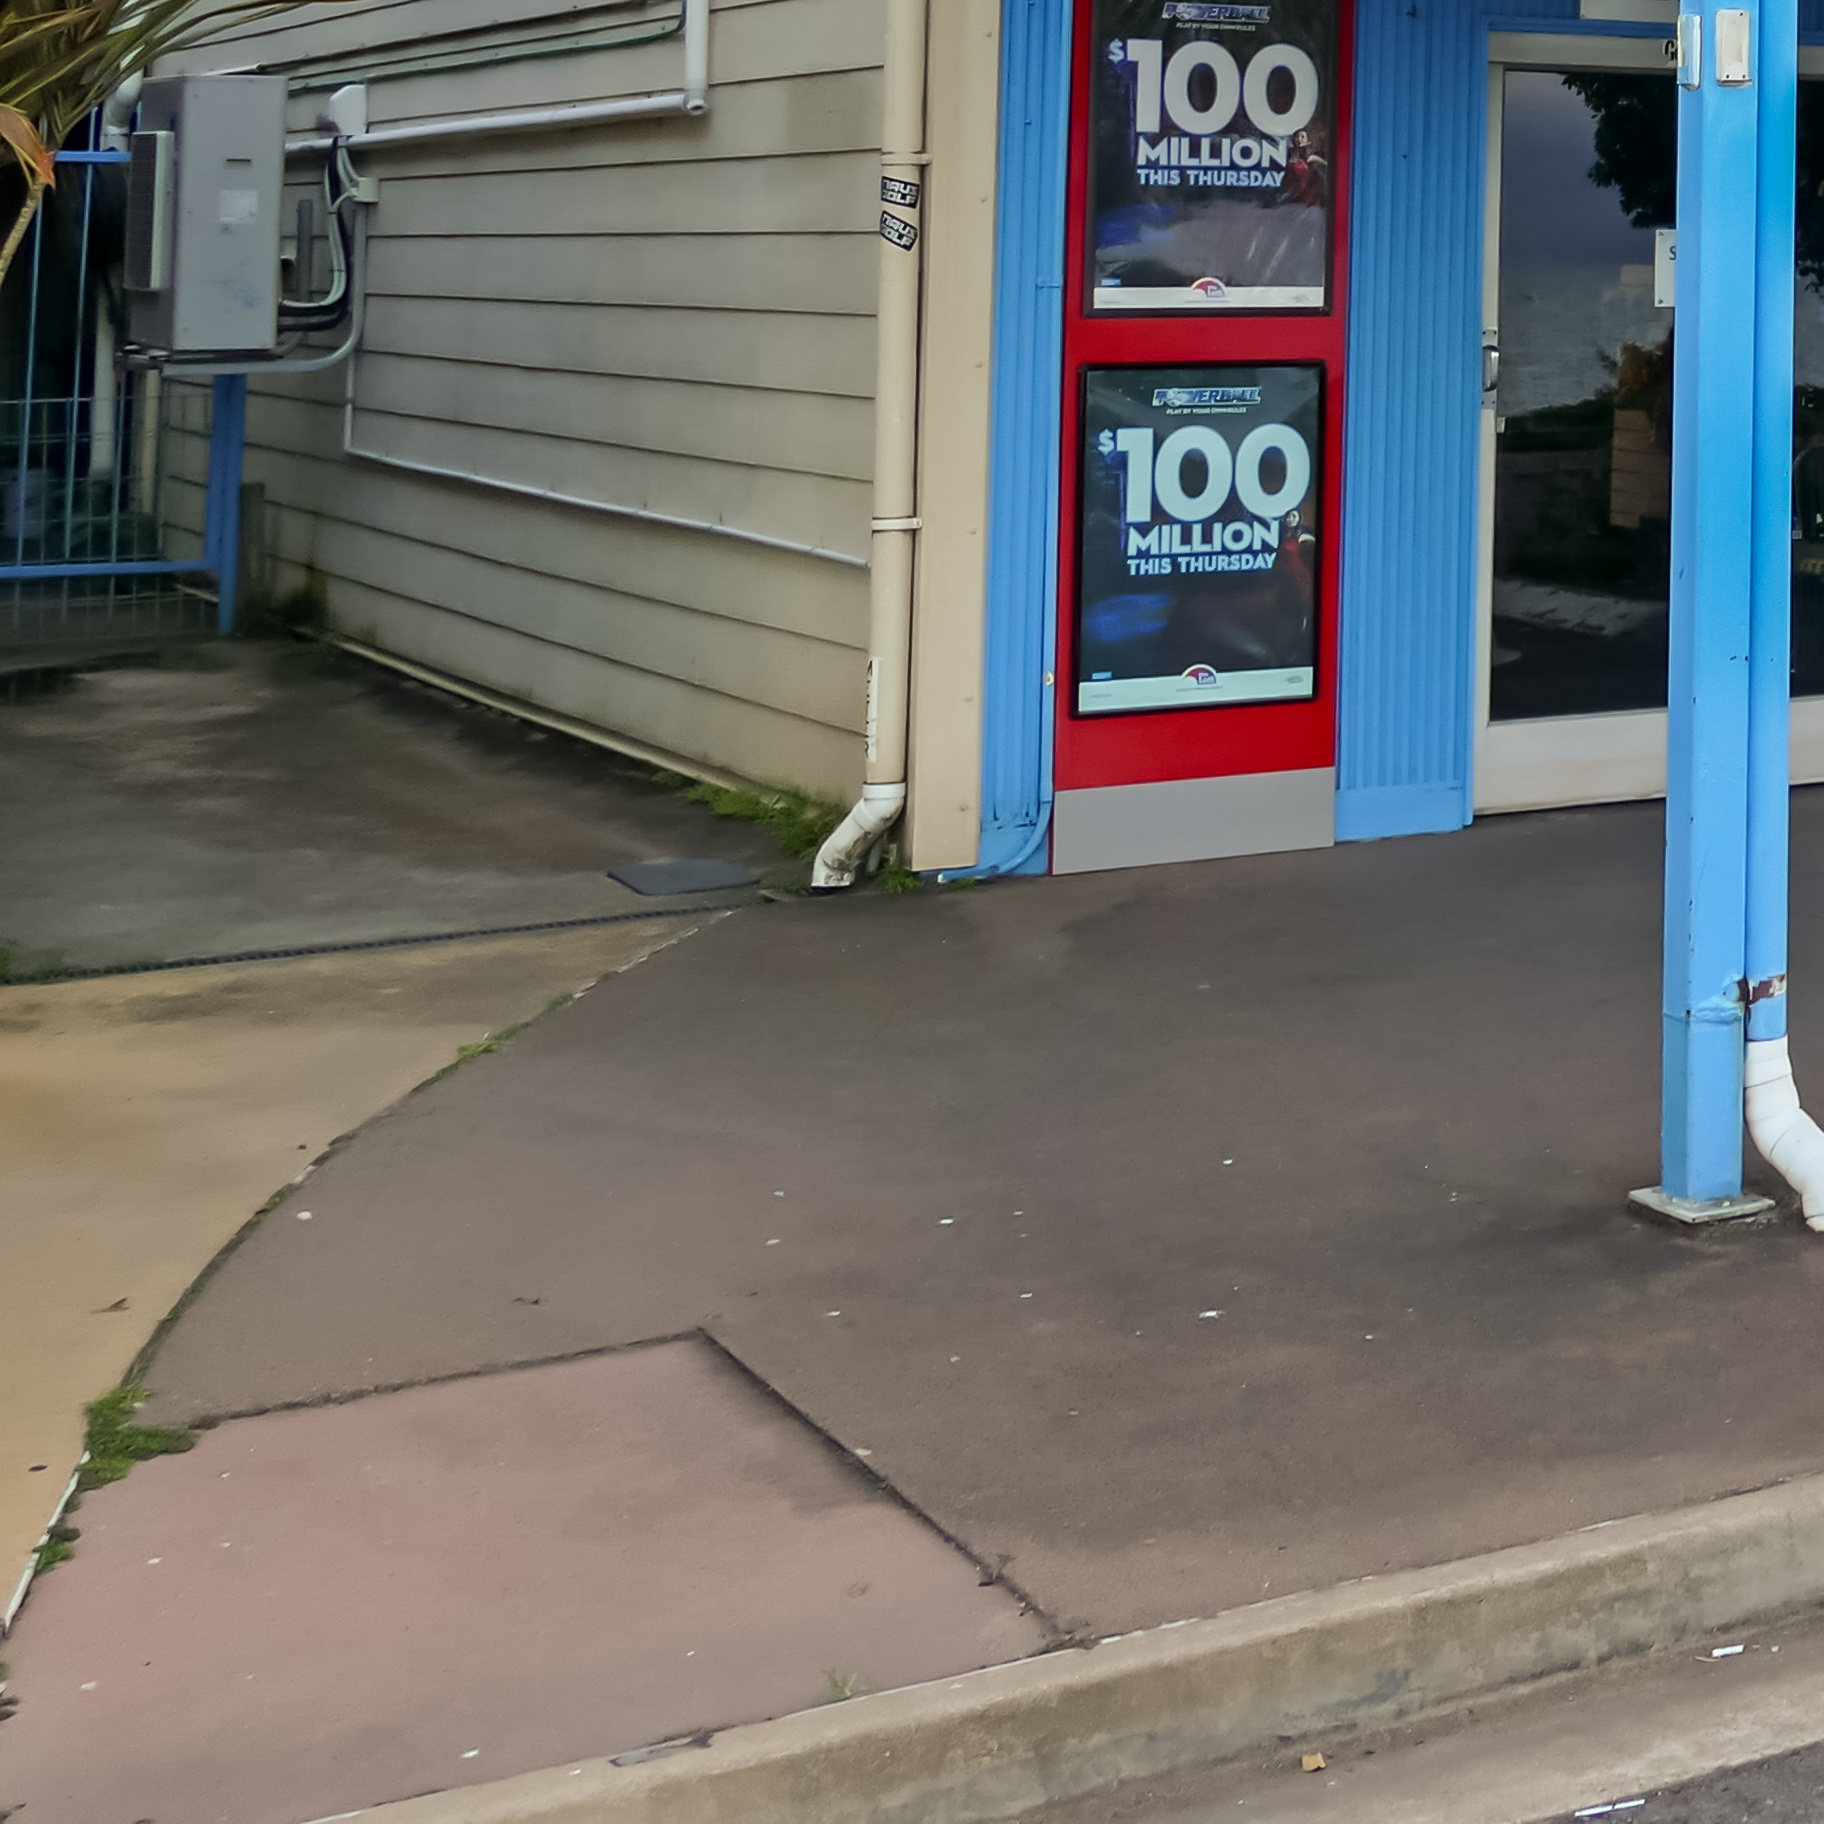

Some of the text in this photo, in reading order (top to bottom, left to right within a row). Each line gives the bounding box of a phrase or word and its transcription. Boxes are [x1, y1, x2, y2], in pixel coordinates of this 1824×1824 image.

[1107, 37, 1320, 136] $100
[1137, 136, 1290, 168] MILLION
[1137, 168, 1286, 188] THIS THURSDAY
[1097, 422, 1311, 525] $100
[1126, 518, 1281, 557] MILLION
[1127, 551, 1278, 576] THIS THURSDAY
